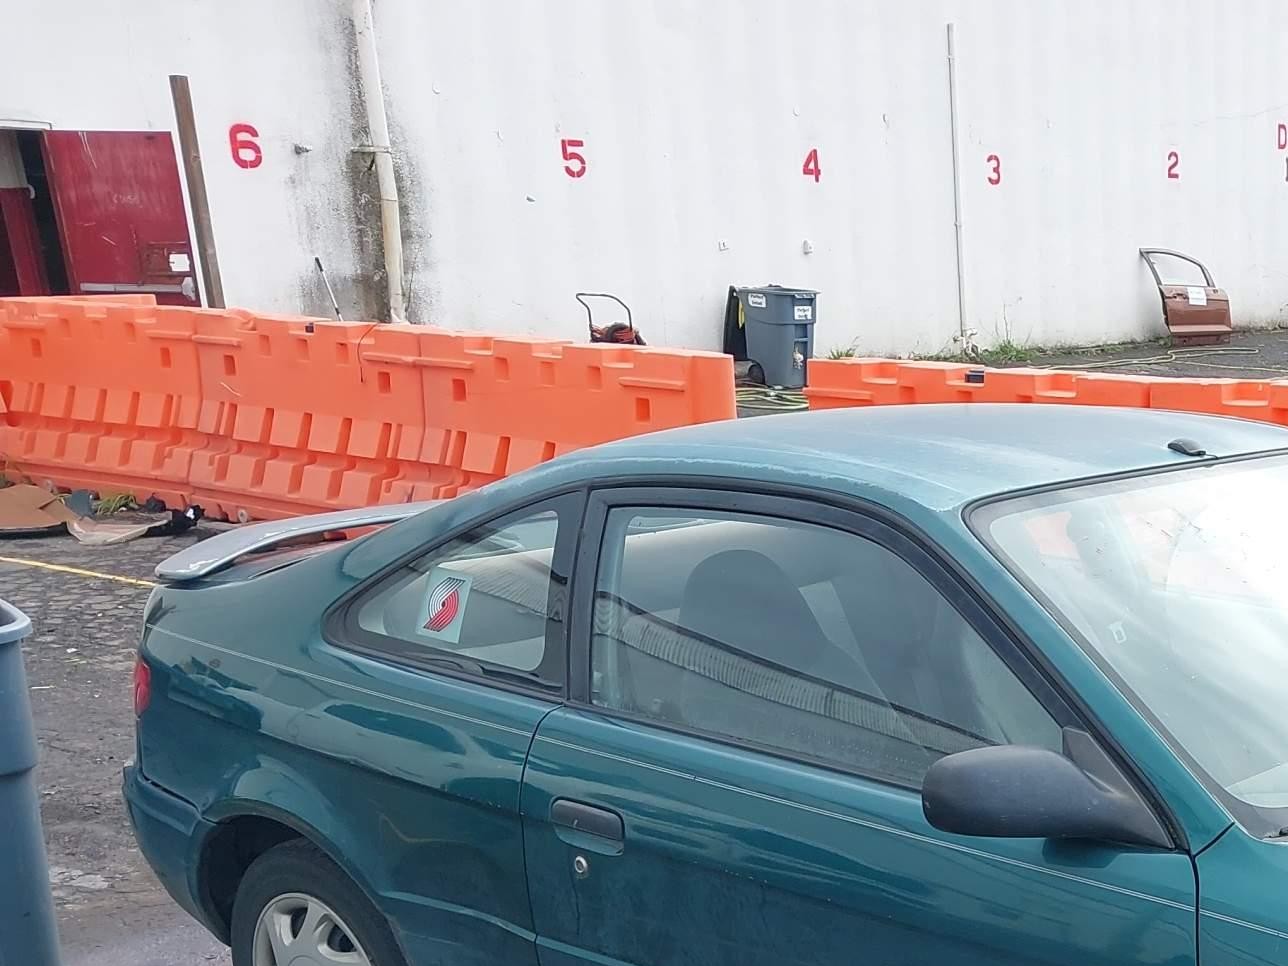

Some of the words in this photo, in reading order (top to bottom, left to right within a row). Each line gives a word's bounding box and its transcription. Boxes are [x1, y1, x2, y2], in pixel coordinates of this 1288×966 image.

[228, 122, 263, 170] 6
[561, 138, 587, 179] 5
[803, 148, 821, 183] 4
[986, 154, 1001, 185] 3
[1167, 151, 1180, 179] 2
